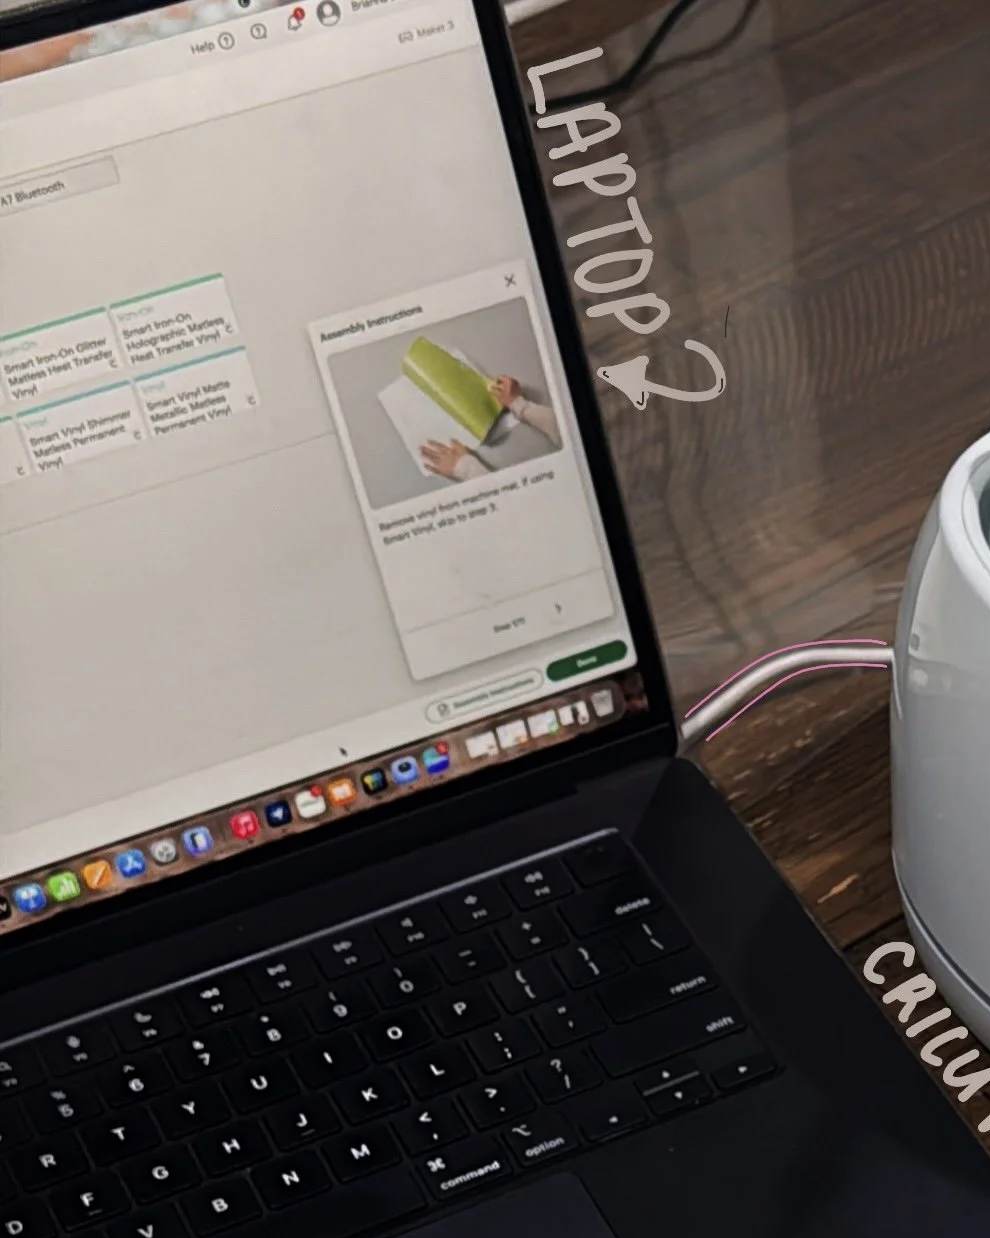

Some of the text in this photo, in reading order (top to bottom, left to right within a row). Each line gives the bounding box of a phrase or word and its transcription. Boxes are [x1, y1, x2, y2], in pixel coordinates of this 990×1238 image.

[190, 42, 215, 55] Help
[14, 180, 66, 203] Bluetooth
[122, 312, 193, 339] Smart Iron-On
[320, 305, 424, 343] Assembly Instructions
[126, 327, 187, 352] Holographic
[130, 330, 222, 364] Heat Transfer Vinyl
[3, 357, 35, 374] Smart
[35, 347, 75, 365] Iron-On
[47, 361, 73, 375] Heat
[73, 350, 113, 367] Transfer
[12, 383, 38, 399] Vinyl
[146, 396, 176, 411] Smart
[177, 386, 201, 402] Vinyl
[154, 404, 232, 435] Permanent Vinyl
[29, 431, 60, 446] Smart
[61, 422, 86, 437] Vinyl
[73, 424, 126, 447] Permanent
[38, 456, 64, 472] Vinyl
[614, 896, 651, 916] delete
[670, 975, 706, 995] return
[453, 1002, 467, 1016] P
[706, 1015, 735, 1033] shift
[387, 1026, 403, 1040] O
[430, 1063, 446, 1077] L
[250, 1075, 268, 1090] U
[361, 1087, 378, 1102] K
[182, 1101, 196, 1115] Y
[297, 1113, 308, 1128] J
[111, 1126, 126, 1141] T
[222, 1138, 241, 1154] H
[350, 1143, 371, 1161] M
[525, 1136, 565, 1158] option
[39, 1153, 57, 1169] R
[152, 1165, 169, 1180] G
[281, 1170, 300, 1186] N
[440, 1160, 501, 1191] command
[80, 1192, 94, 1208] F
[211, 1198, 229, 1213] B
[6, 1220, 24, 1235] D
[137, 1224, 154, 1238] V
